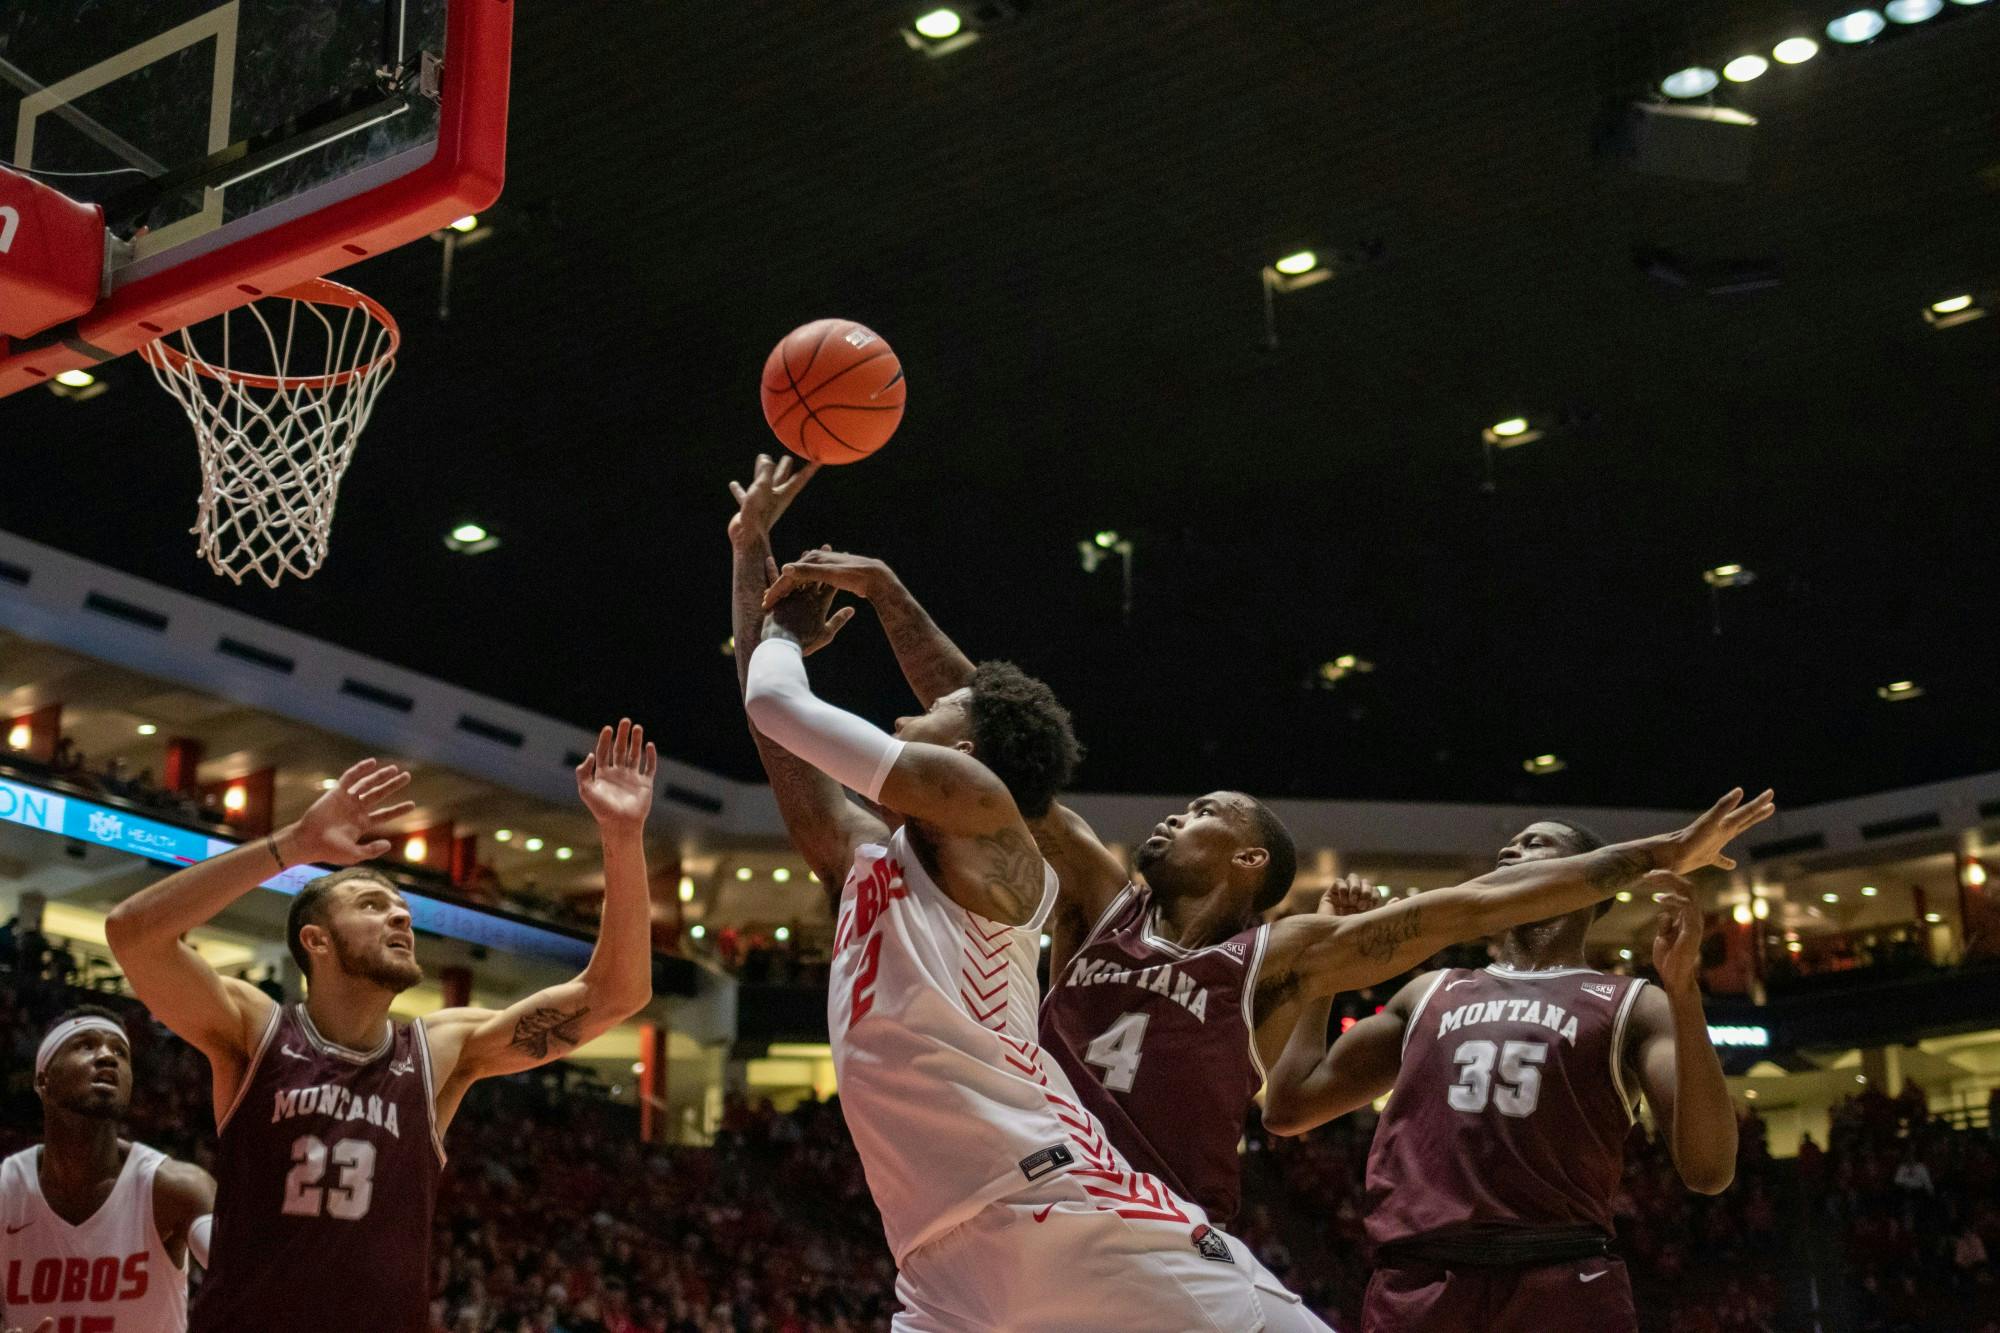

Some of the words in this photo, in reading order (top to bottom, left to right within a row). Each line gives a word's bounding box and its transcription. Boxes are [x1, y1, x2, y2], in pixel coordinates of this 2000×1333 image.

[127, 828, 176, 847] HEALTH
[849, 931, 883, 1031] 2
[1065, 957, 1208, 1024] MONTANA
[1084, 1012, 1150, 1093] 4
[1437, 1000, 1578, 1048] MONTANA
[1447, 1040, 1549, 1118] 35
[271, 1083, 400, 1139] MONTANA
[281, 1134, 377, 1220] 23
[1055, 1151, 1065, 1160] L
[6, 1251, 150, 1305] LOBOS
